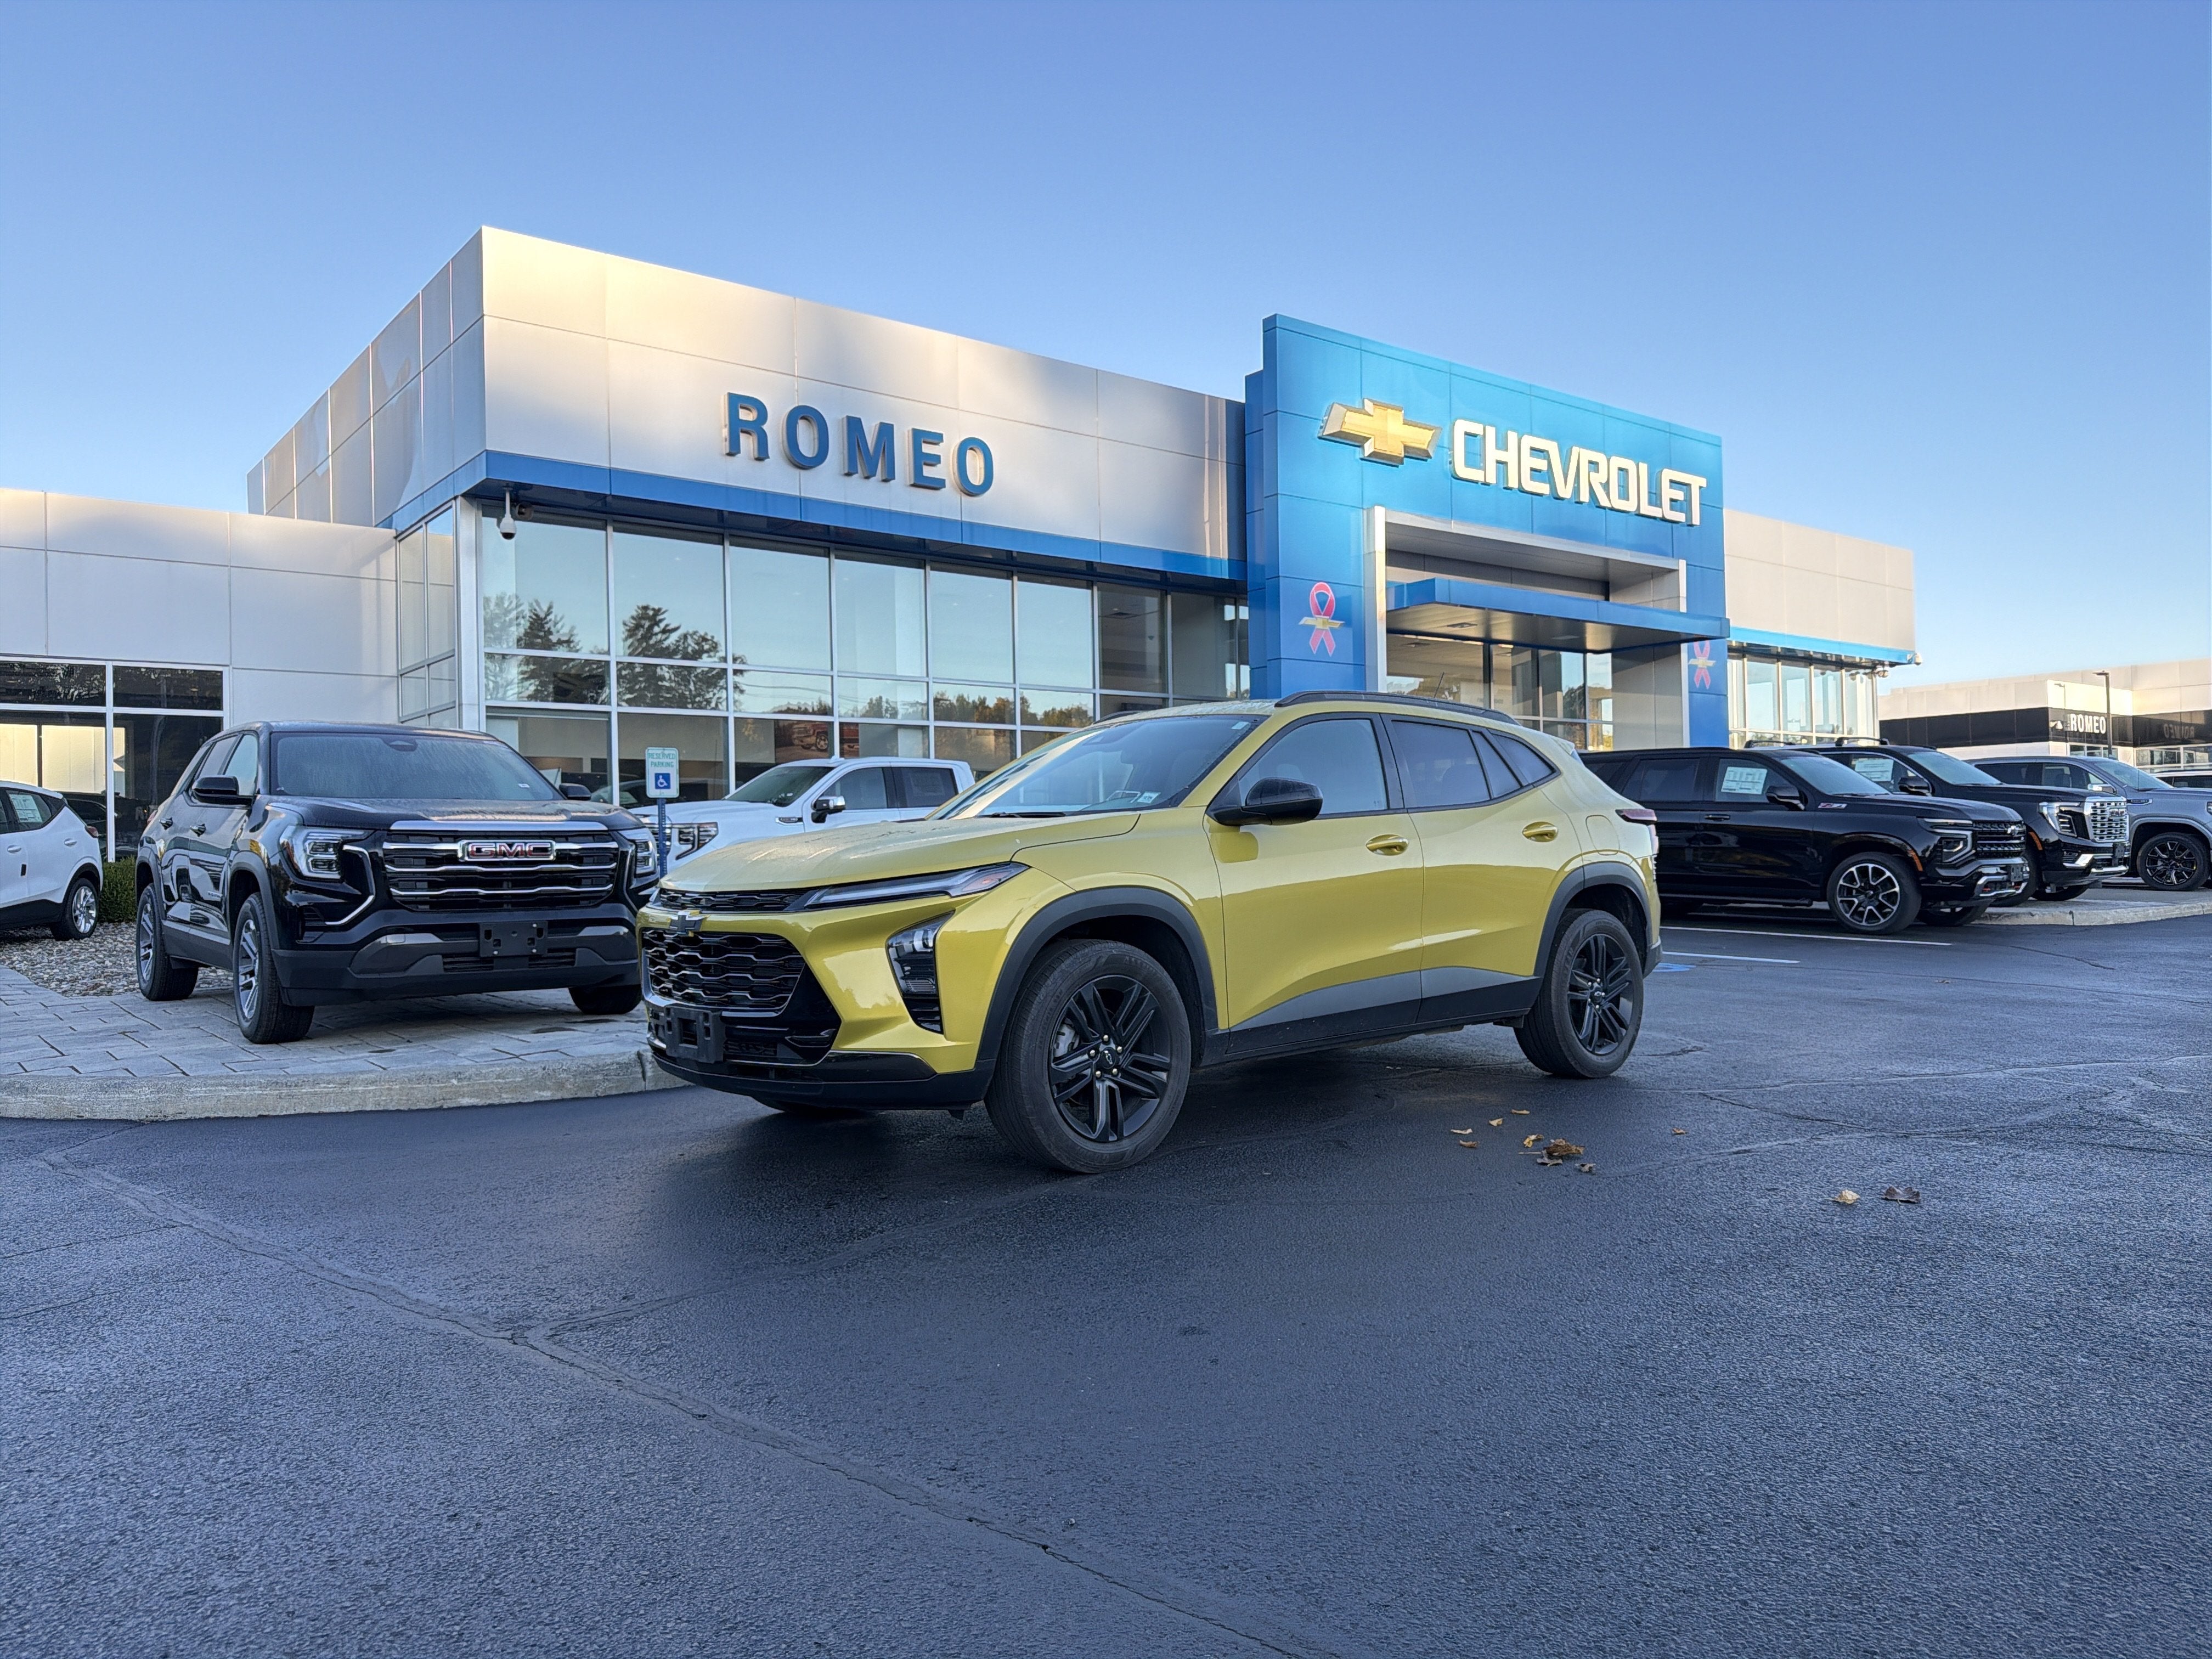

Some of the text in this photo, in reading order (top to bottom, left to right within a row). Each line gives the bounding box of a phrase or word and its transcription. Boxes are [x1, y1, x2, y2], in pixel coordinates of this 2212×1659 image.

[723, 392, 994, 496] ROMEO
[1453, 419, 1707, 526] CHEVROLET
[2070, 713, 2106, 733] ROMEO
[468, 843, 551, 858] GMC
